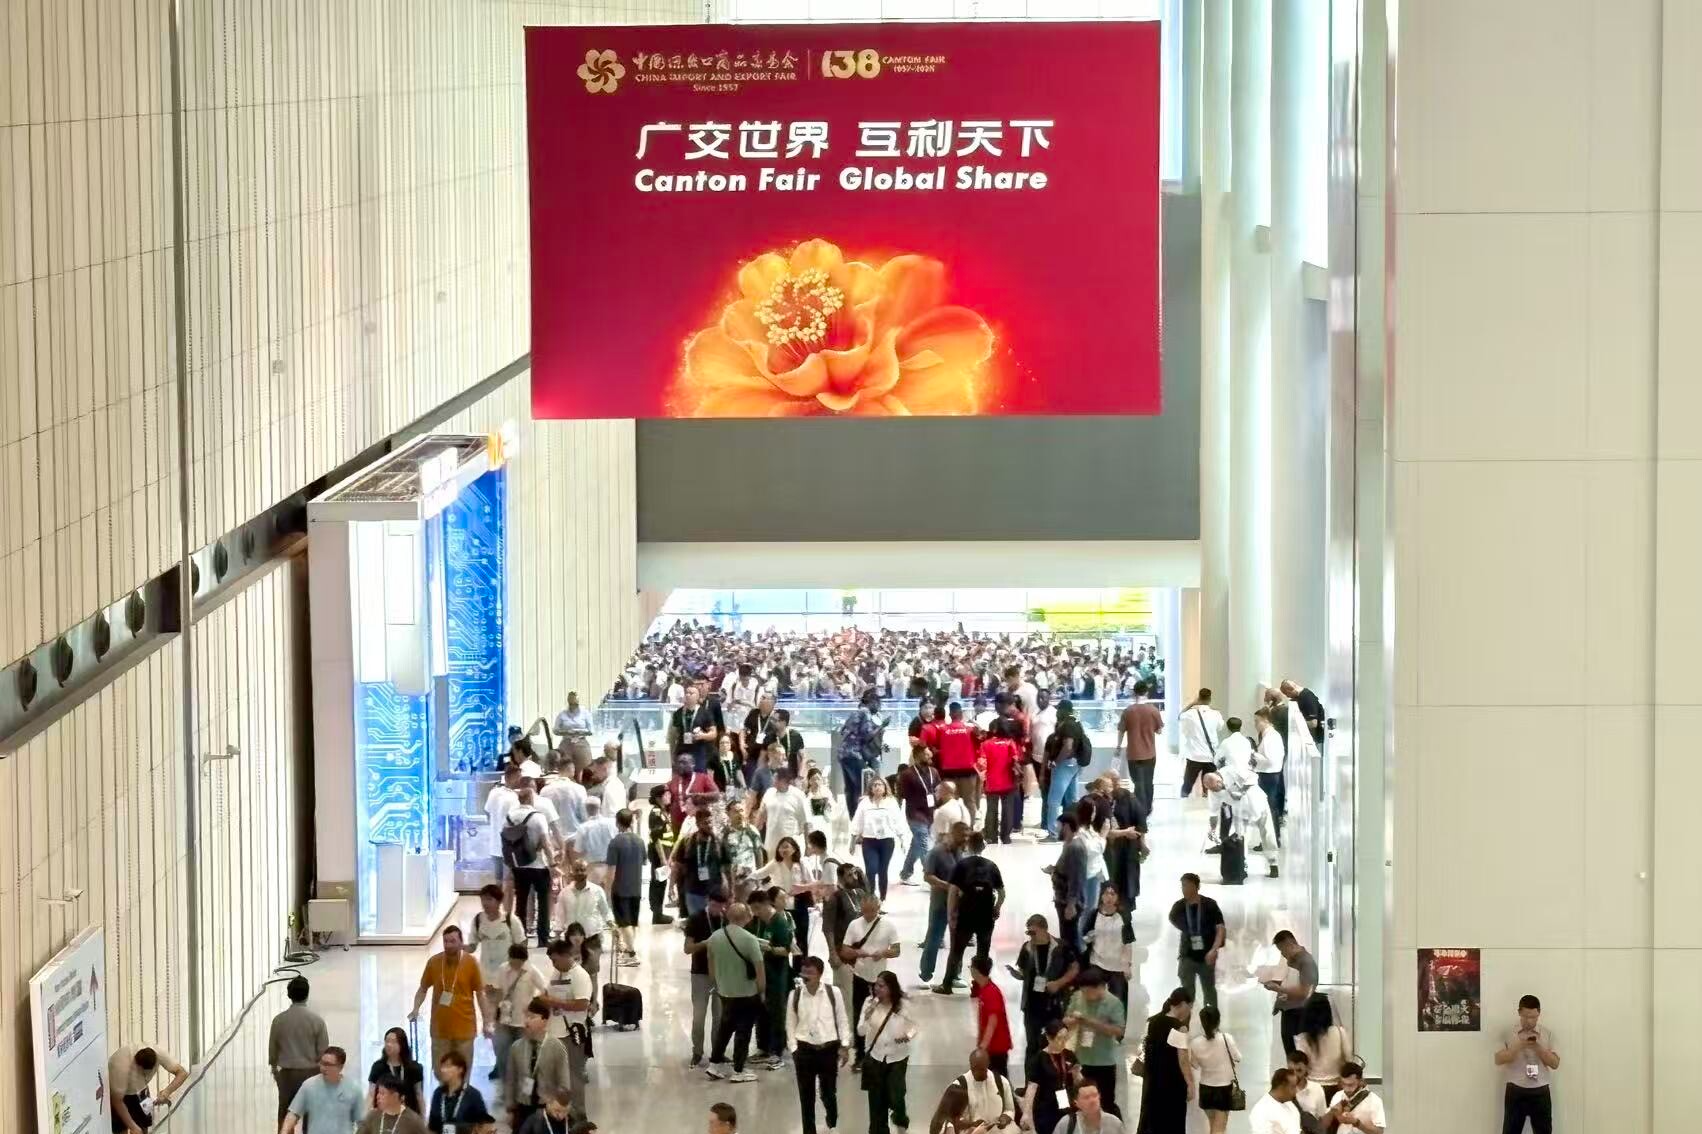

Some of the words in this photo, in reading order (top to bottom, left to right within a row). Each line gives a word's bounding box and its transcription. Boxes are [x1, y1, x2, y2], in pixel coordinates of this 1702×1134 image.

[821, 49, 881, 79] 138
[882, 56, 922, 65] CANTON
[924, 55, 946, 64] FAIR
[635, 74, 667, 82] CHINA
[709, 73, 732, 81] AND
[734, 72, 772, 81] EXPORT
[774, 72, 797, 81] FAIR
[692, 83, 716, 92] Since
[718, 83, 739, 92] 1957
[635, 120, 829, 160] 广交世界
[855, 118, 1055, 158] 互利天下
[634, 167, 747, 192] Canton
[758, 166, 821, 191] Fair
[839, 165, 946, 191] Global
[955, 165, 1048, 190] Share
